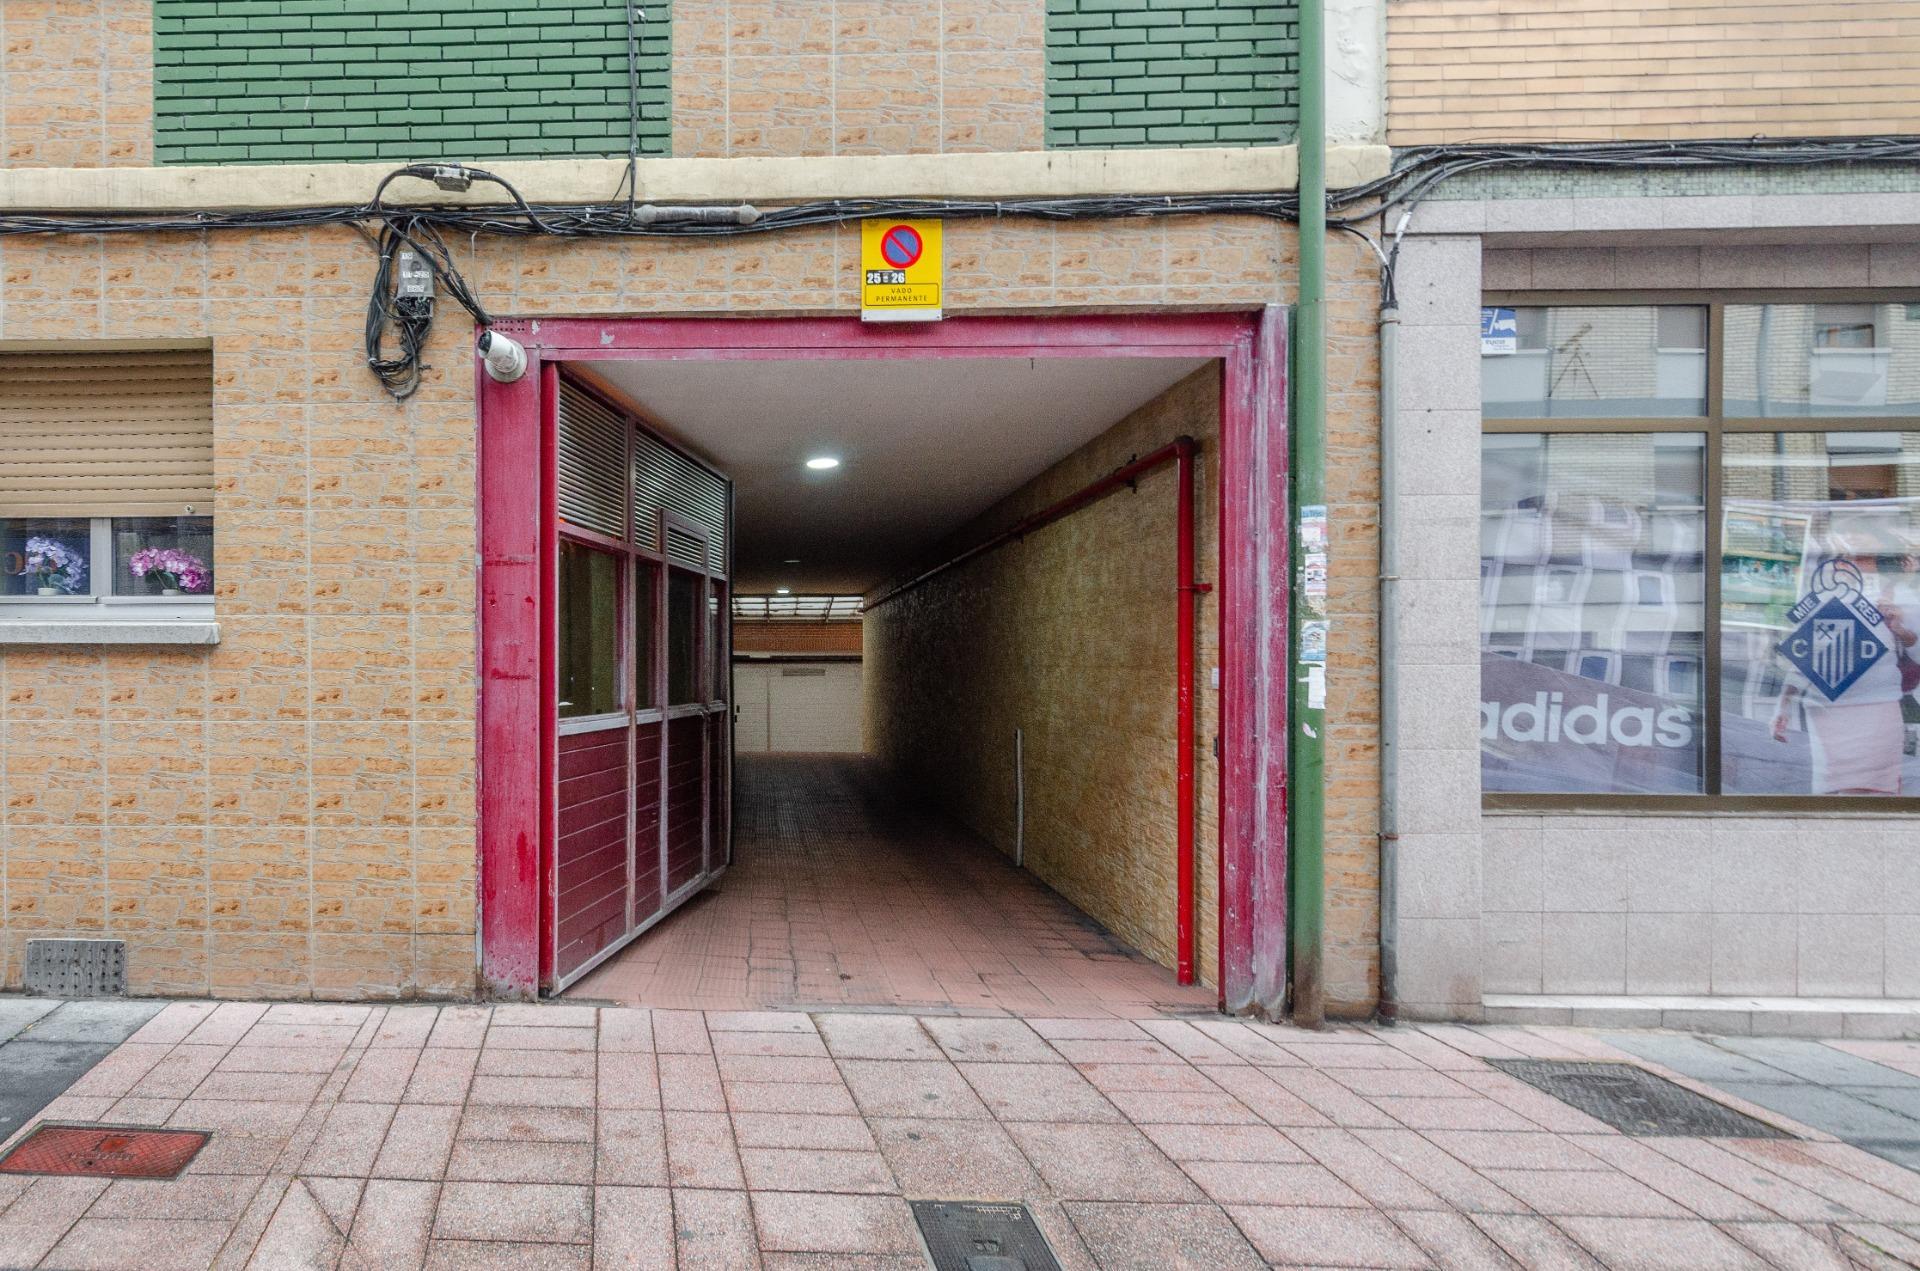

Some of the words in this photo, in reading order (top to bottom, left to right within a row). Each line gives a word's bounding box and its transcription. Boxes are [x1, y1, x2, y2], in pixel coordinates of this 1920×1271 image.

[867, 272, 881, 284] 25
[891, 272, 905, 284] 26
[1792, 595, 1816, 620] MIE
[1855, 598, 1881, 626] RES
[1791, 639, 1809, 658] C
[1861, 640, 1878, 659] D
